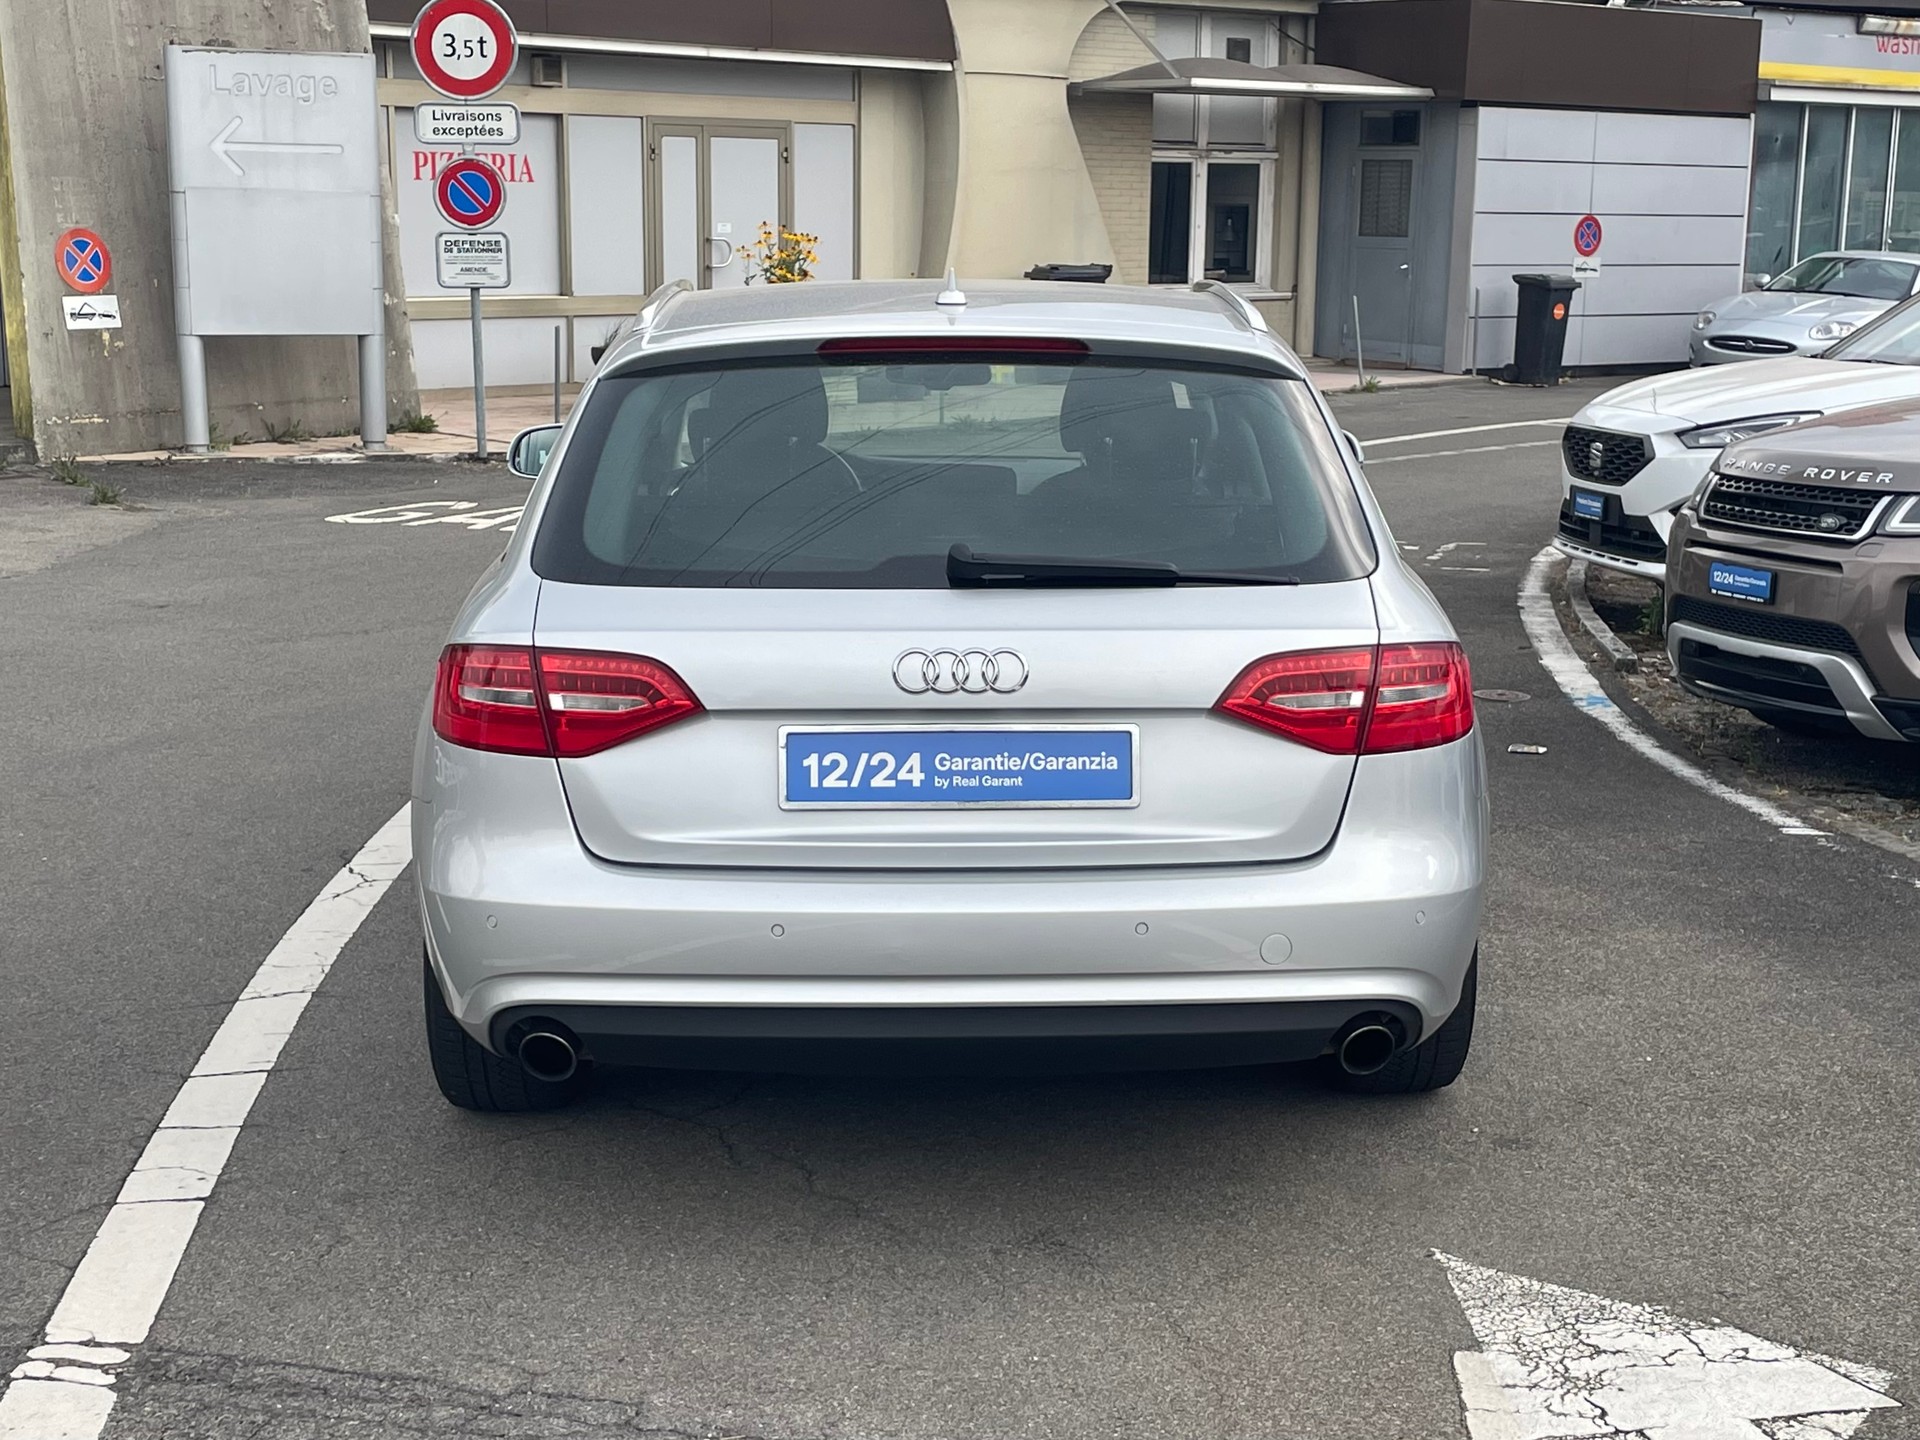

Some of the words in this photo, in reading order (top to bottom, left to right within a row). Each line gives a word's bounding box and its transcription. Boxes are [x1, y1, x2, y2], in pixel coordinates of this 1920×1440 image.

[208, 63, 338, 105] Lavage
[432, 109, 503, 122] Livraisons
[432, 124, 504, 138] exceptées
[1725, 458, 1791, 475] RANGE
[1803, 467, 1894, 484] ROVER
[324, 501, 528, 532] GA
[1713, 570, 1734, 585] 12/24
[802, 752, 925, 788] 12/24
[934, 751, 1118, 772] Garantie/Garanzia
[934, 775, 949, 789] by
[952, 775, 979, 787] Real
[981, 775, 1023, 787] Garant
